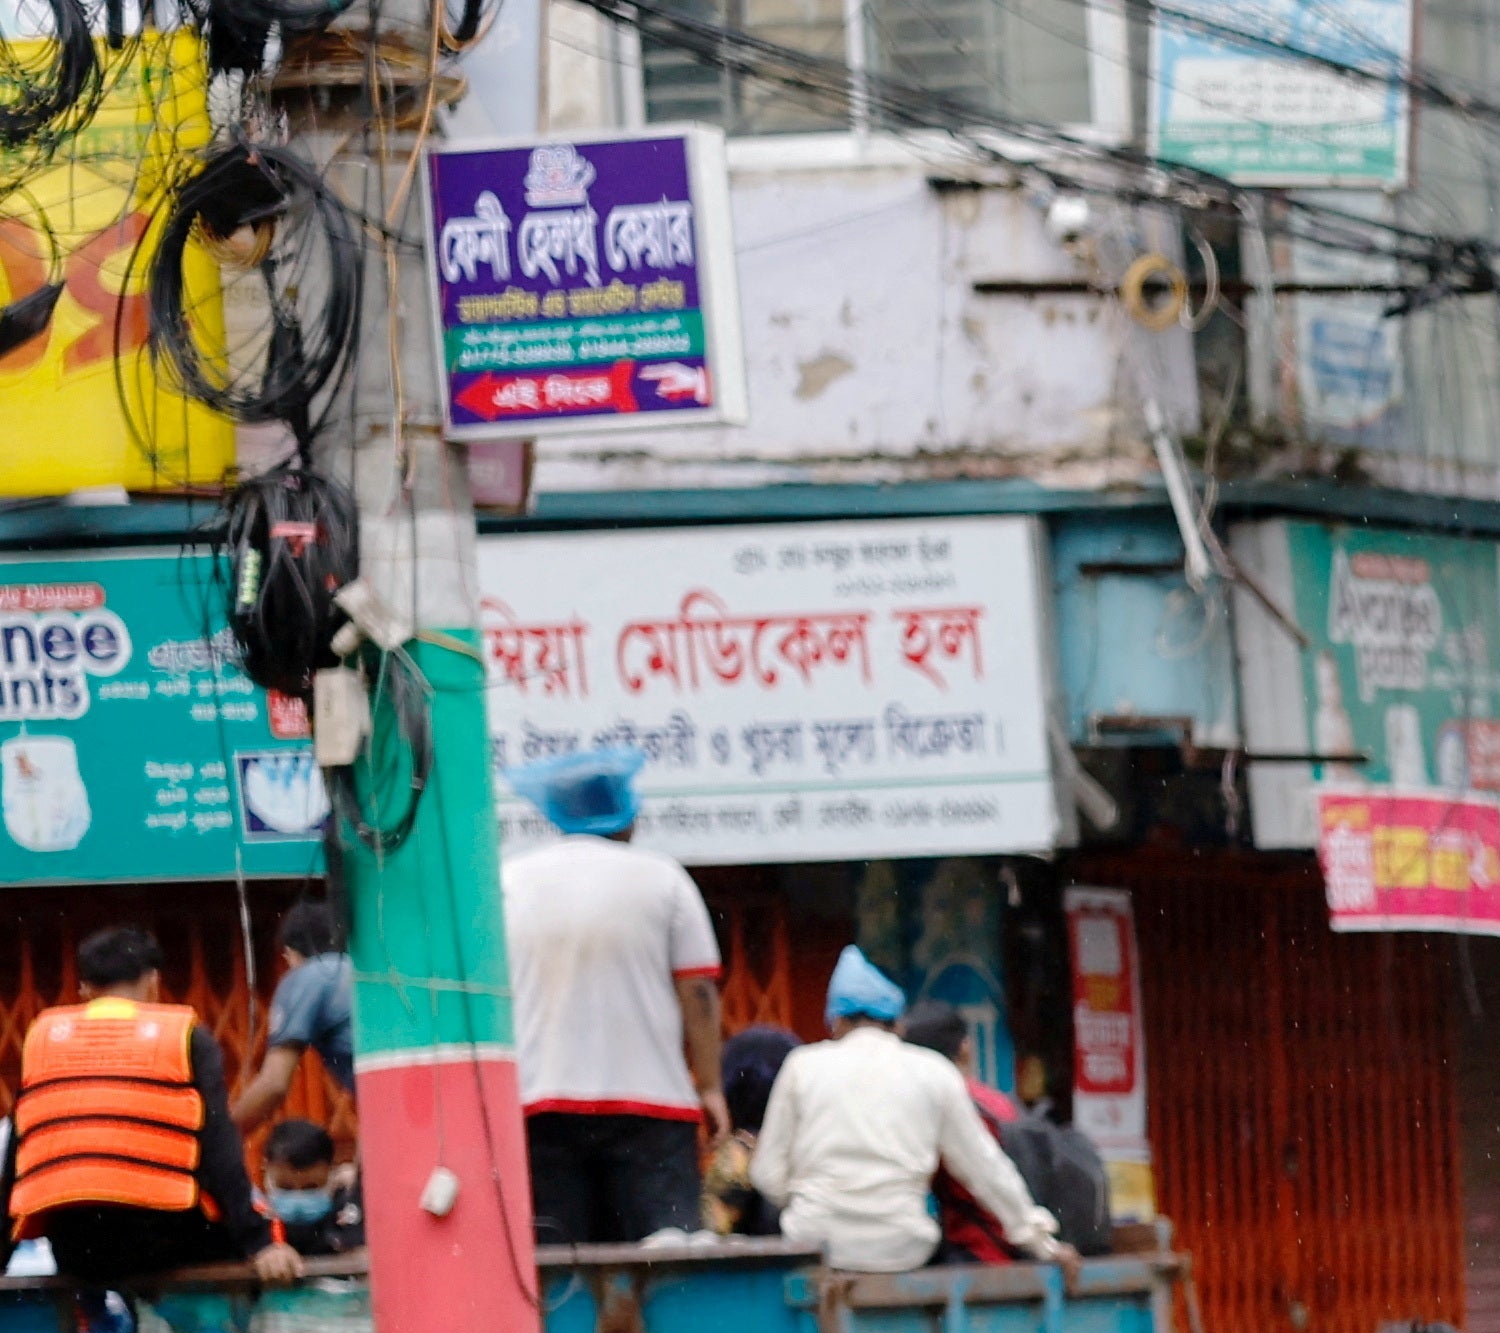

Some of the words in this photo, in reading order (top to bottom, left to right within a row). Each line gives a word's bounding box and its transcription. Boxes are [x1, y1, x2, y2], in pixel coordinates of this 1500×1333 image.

[440, 190, 512, 284] ফেনী
[604, 194, 695, 273] কেয়ার
[493, 376, 539, 409] এই
[545, 373, 612, 407] দিকে
[1, 623, 119, 664] nee
[480, 596, 590, 698] ম্বিয়া
[617, 588, 873, 693] মেডিকেল
[891, 604, 986, 693] হল
[742, 720, 804, 775] খুচরা
[884, 701, 985, 760] বিক্রেতা
